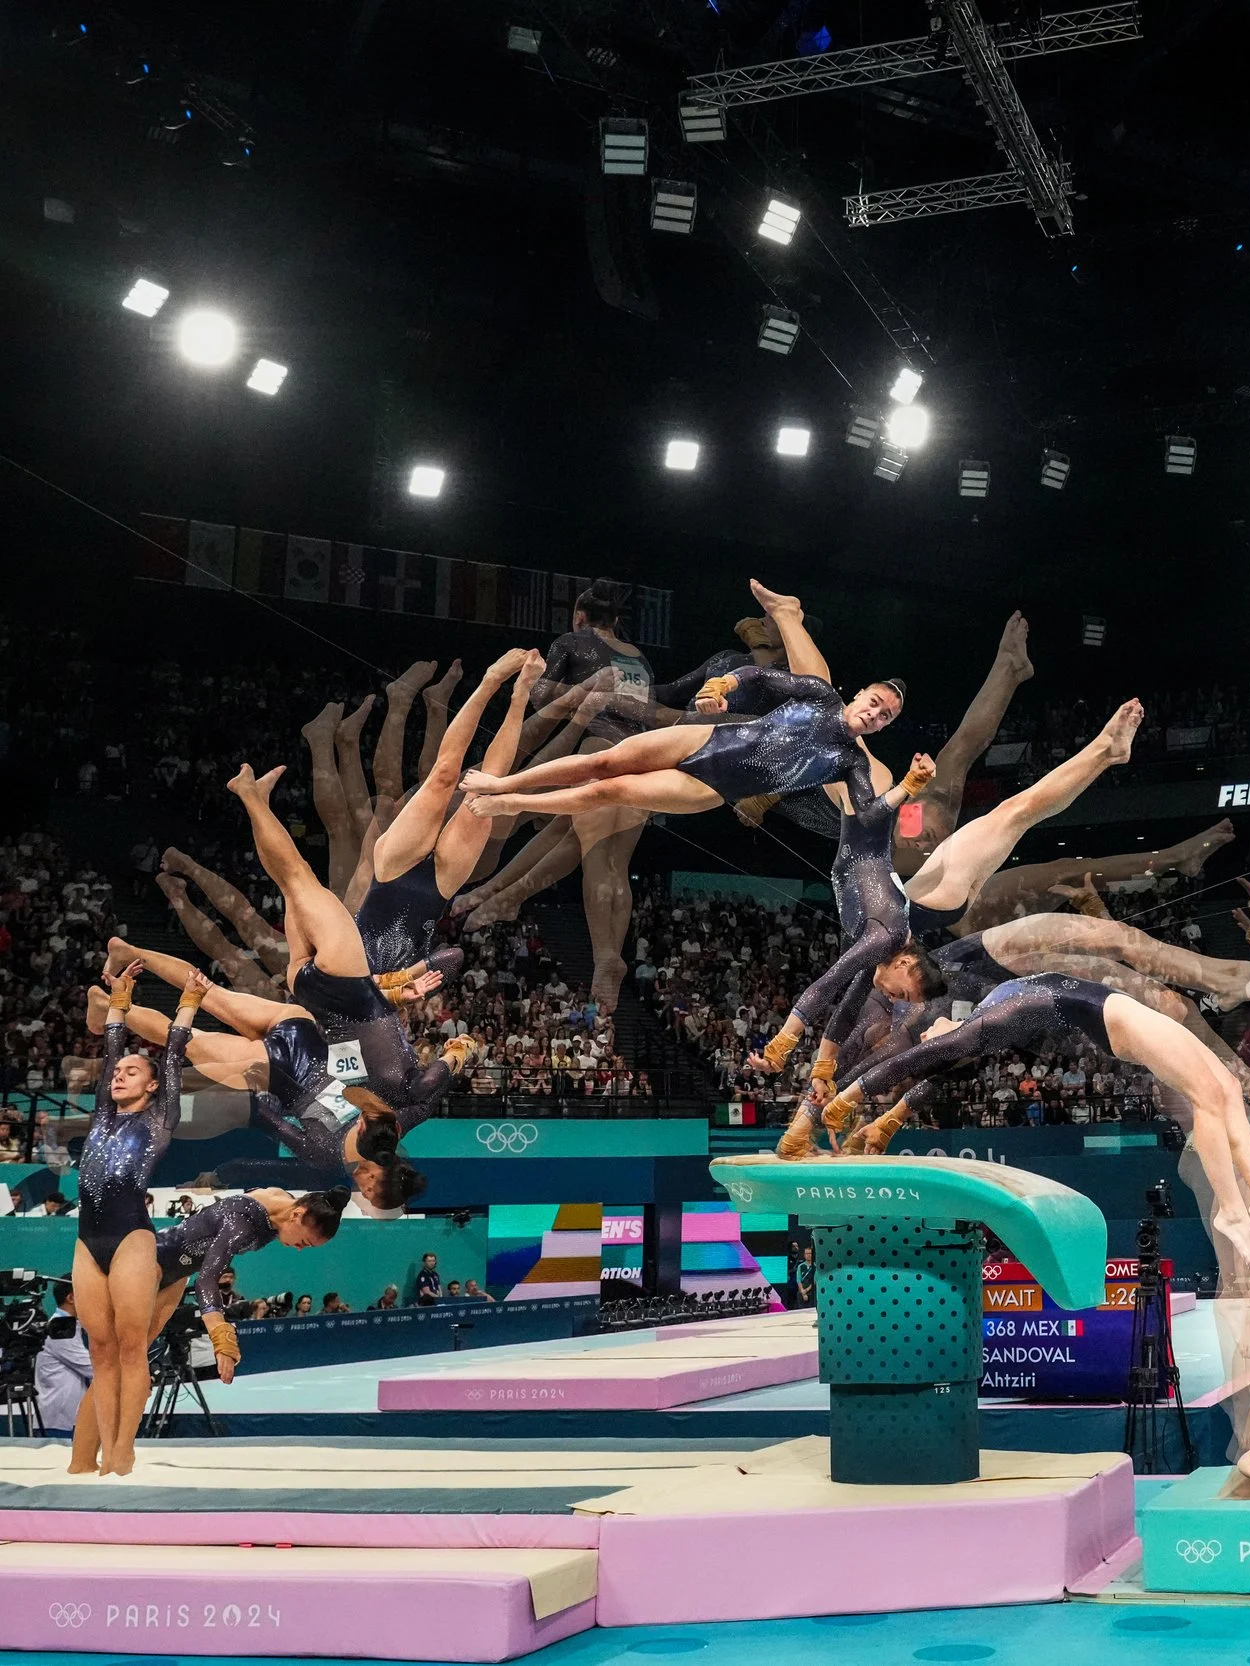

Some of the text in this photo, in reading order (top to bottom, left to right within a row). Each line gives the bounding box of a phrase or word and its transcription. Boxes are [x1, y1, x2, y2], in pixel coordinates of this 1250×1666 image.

[336, 1056, 359, 1073] 315
[865, 1188, 920, 1201] 2024
[987, 1289, 1035, 1307] WAIT
[987, 1320, 1060, 1337] 368 MEX
[982, 1347, 1076, 1364] SANDOVAL
[981, 1371, 1036, 1388] Ahtziri
[531, 1388, 565, 1399] 2024
[934, 1386, 951, 1394] 125
[203, 1603, 281, 1628] 2024
